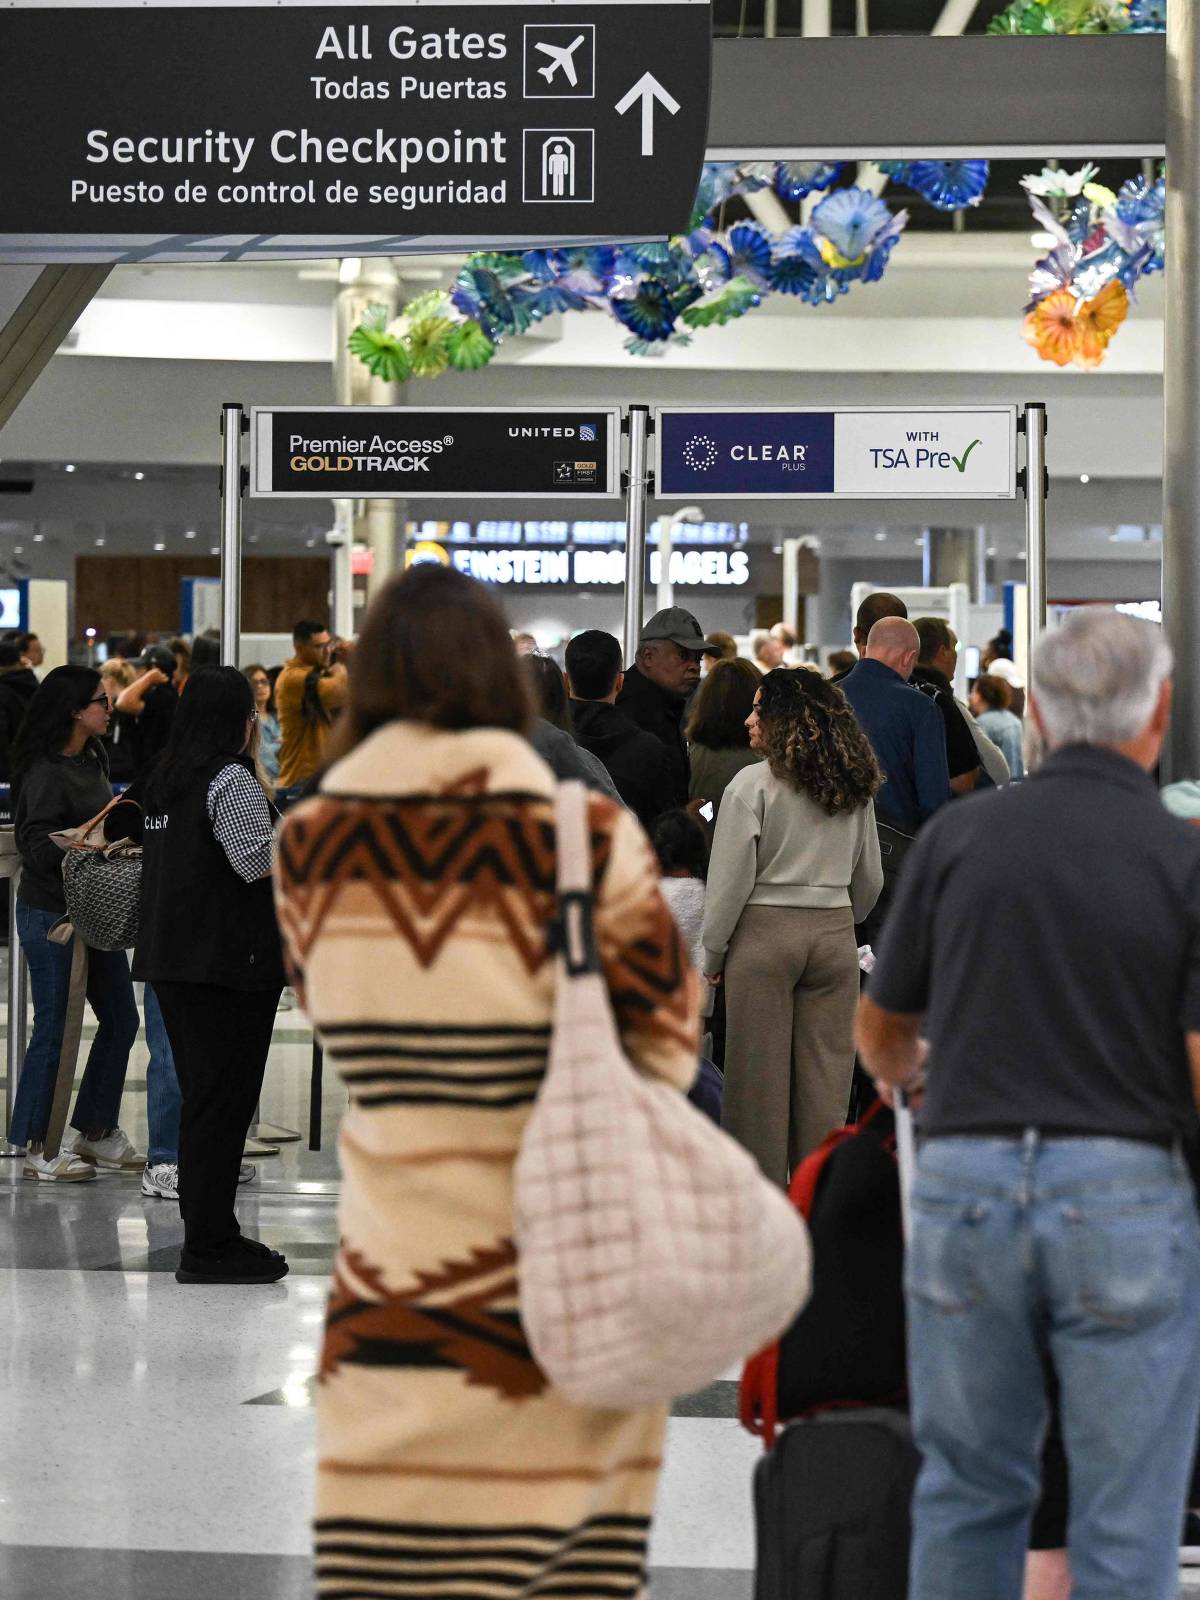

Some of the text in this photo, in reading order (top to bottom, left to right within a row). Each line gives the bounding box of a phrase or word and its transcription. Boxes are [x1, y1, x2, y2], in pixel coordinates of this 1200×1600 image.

[315, 25, 508, 60] All Gates
[310, 76, 507, 100] Todas Puertas
[86, 129, 507, 174] Security Checkpoint
[71, 179, 507, 211] Puesto de control de seguridad
[508, 427, 576, 438] UNITED
[905, 431, 939, 442] WITH
[289, 434, 367, 453] Premier
[730, 445, 806, 461] CLEAR
[289, 456, 430, 472] GOLDTRACK
[781, 463, 806, 471] PLUS
[869, 448, 951, 469] TSA Pre
